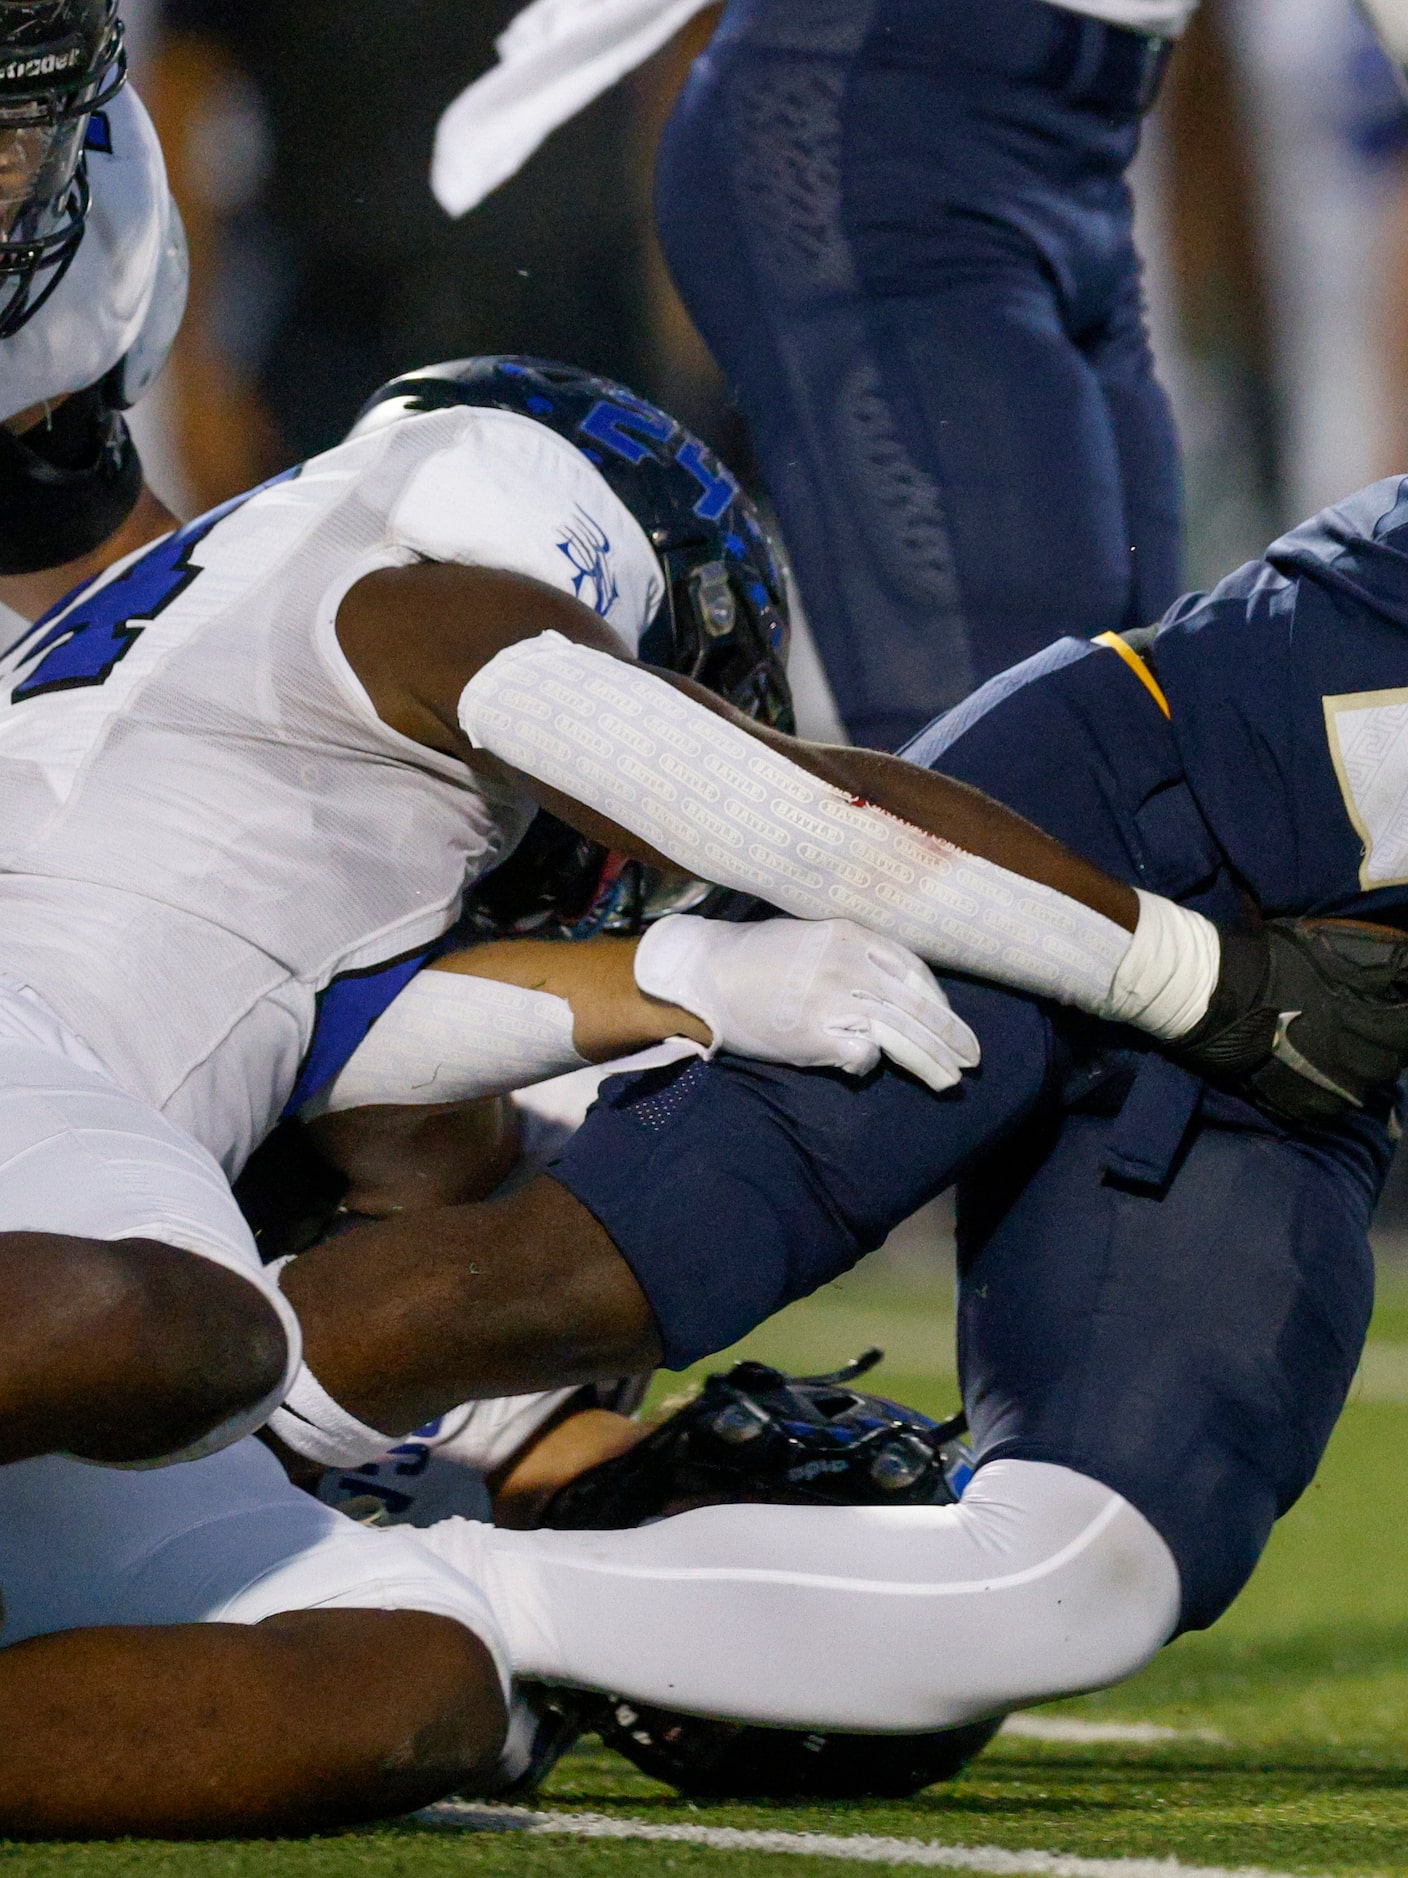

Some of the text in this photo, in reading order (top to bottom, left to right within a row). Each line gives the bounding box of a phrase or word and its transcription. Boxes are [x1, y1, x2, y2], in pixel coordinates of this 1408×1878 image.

[587, 681, 640, 712] BATTLE
[557, 717, 610, 755] BATTLE
[601, 716, 653, 753] BATTLE
[646, 717, 698, 753] BATTLE
[692, 721, 743, 756] BATTLE
[580, 760, 633, 798] BATTLE
[620, 758, 674, 798] BATTLE
[662, 756, 717, 799] BATTLE
[706, 757, 764, 798] BATTLE
[751, 760, 810, 800] BATTLE
[684, 801, 741, 845] BATTLE
[727, 801, 787, 843] BATTLE
[773, 801, 841, 842] BATTLE
[822, 802, 886, 837] BATTLE
[708, 846, 772, 884] BATTLE
[751, 846, 820, 886] BATTLE
[799, 845, 868, 884] BATTLE
[852, 842, 911, 880] BATTLE
[897, 839, 949, 873] BATTLE
[832, 887, 893, 924] BATTLE
[879, 886, 934, 920] BATTLE
[922, 880, 976, 913] BATTLE
